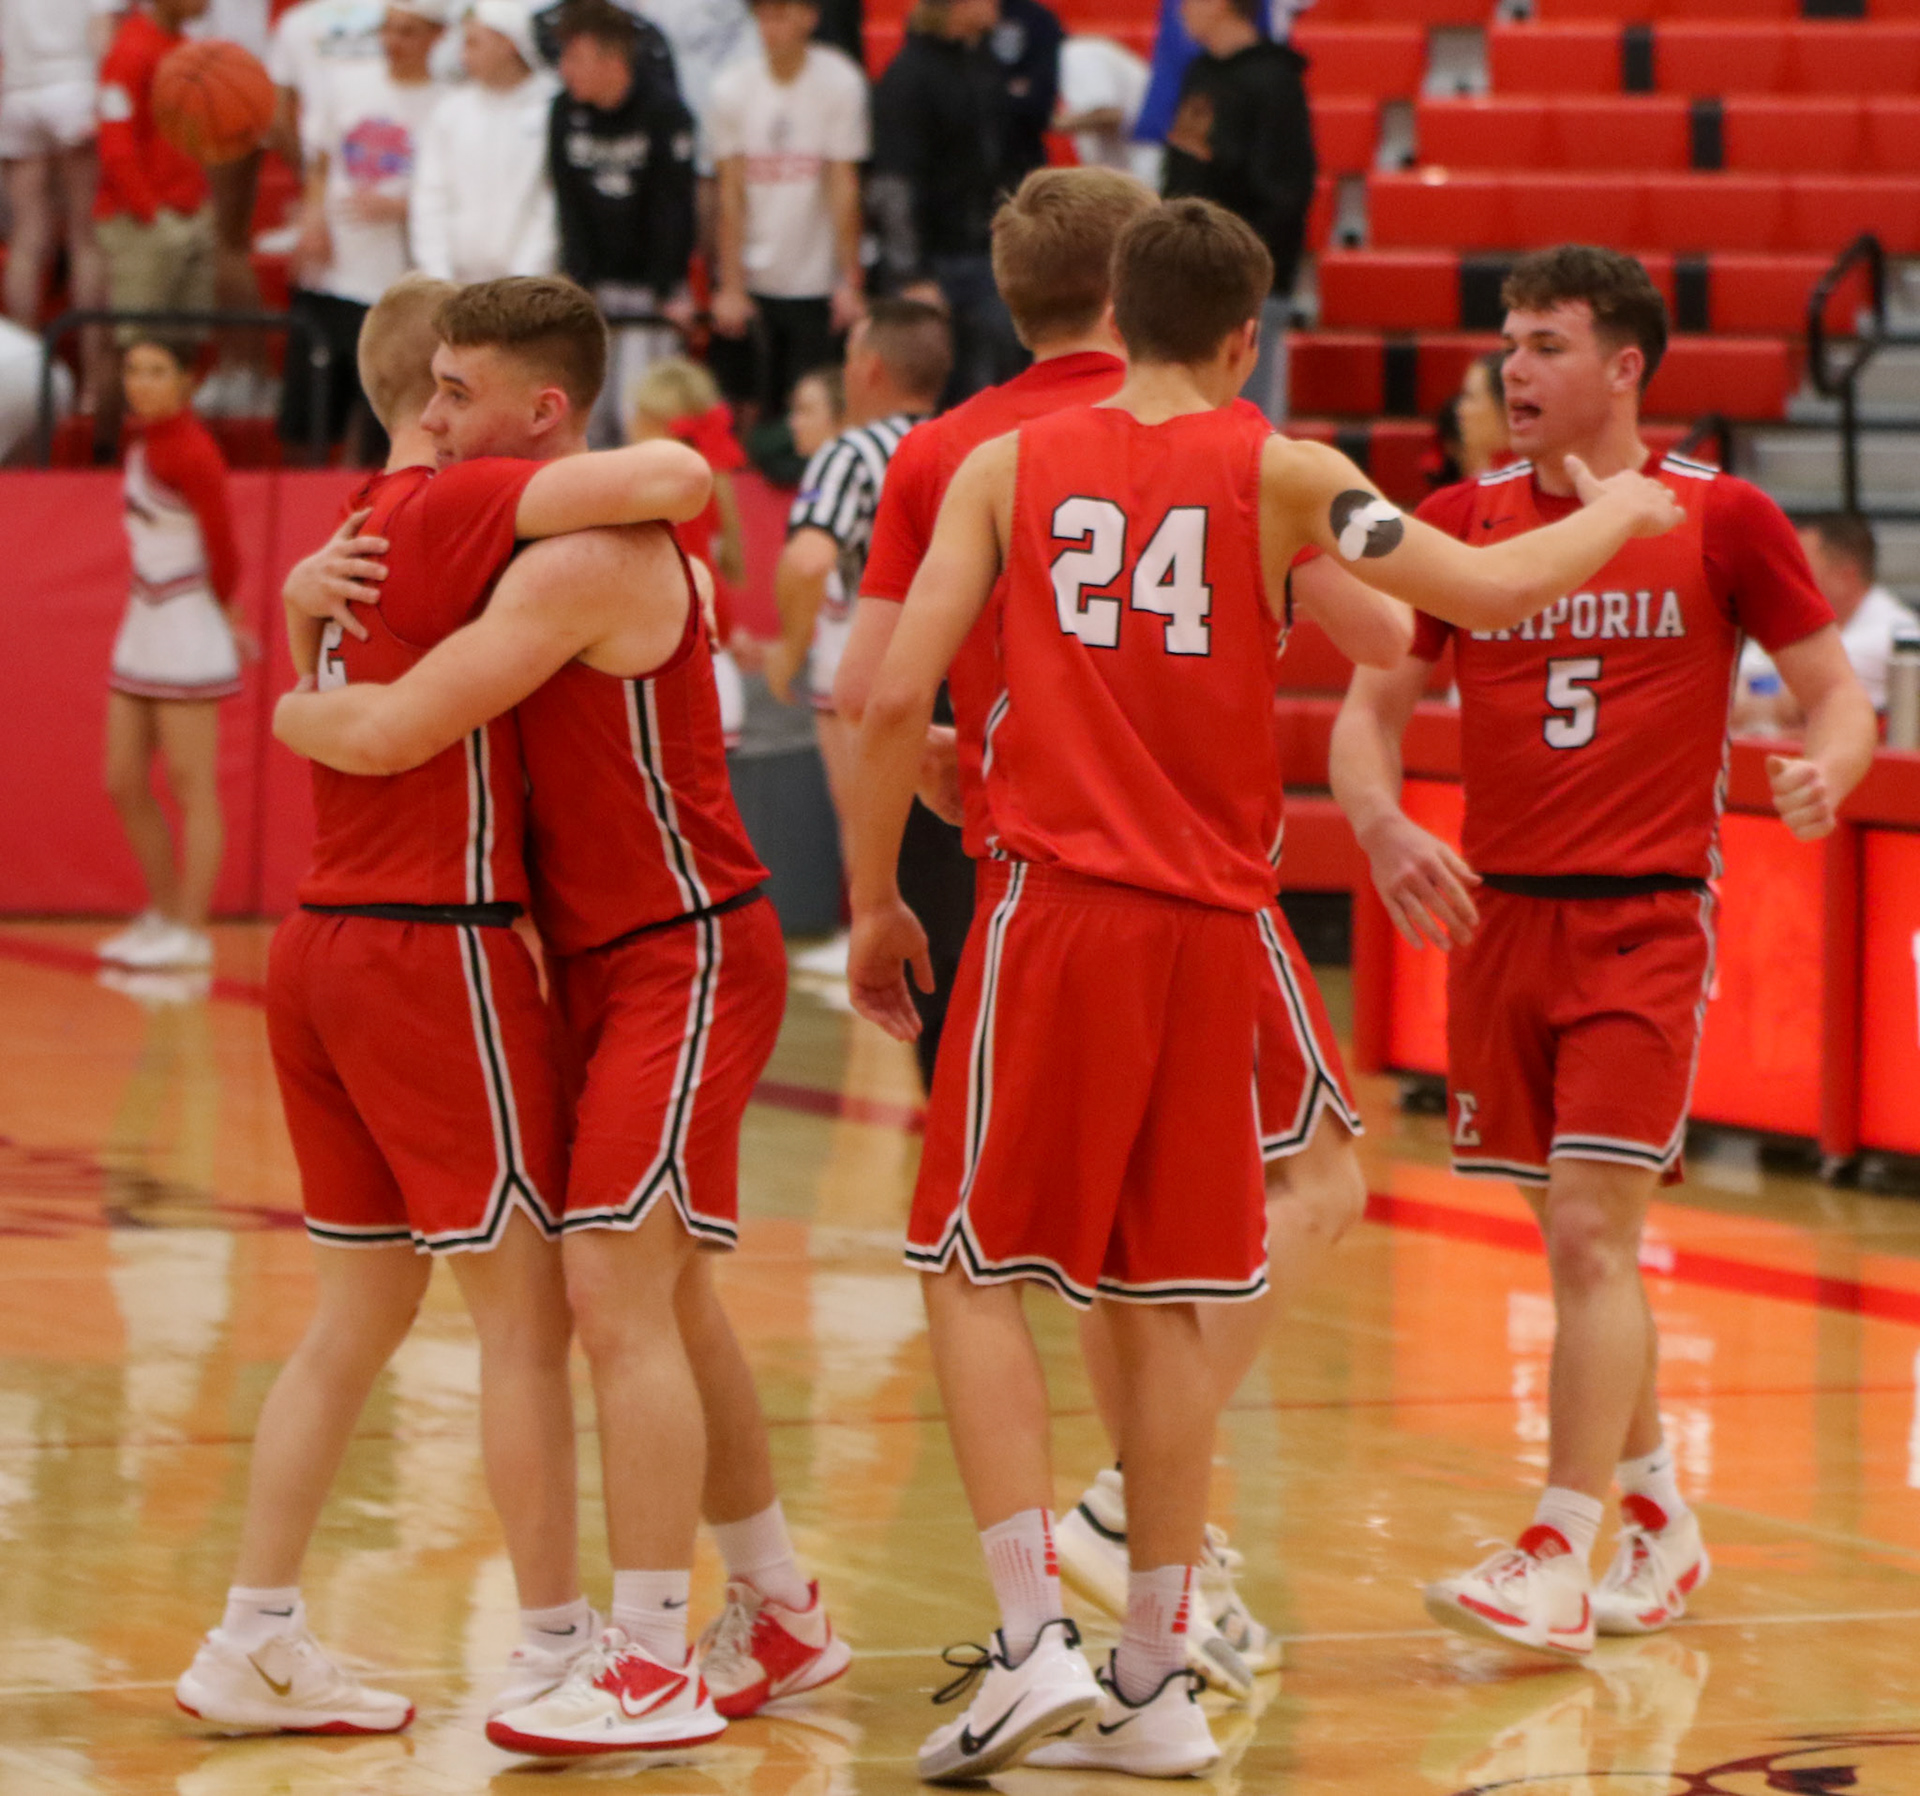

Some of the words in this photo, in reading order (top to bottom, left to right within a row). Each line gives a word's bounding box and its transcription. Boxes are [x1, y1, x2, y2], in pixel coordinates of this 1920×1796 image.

[1050, 495, 1213, 656] 24
[1469, 588, 1688, 642] PORIA
[1543, 656, 1602, 750] 5
[1453, 1091, 1482, 1147] E
